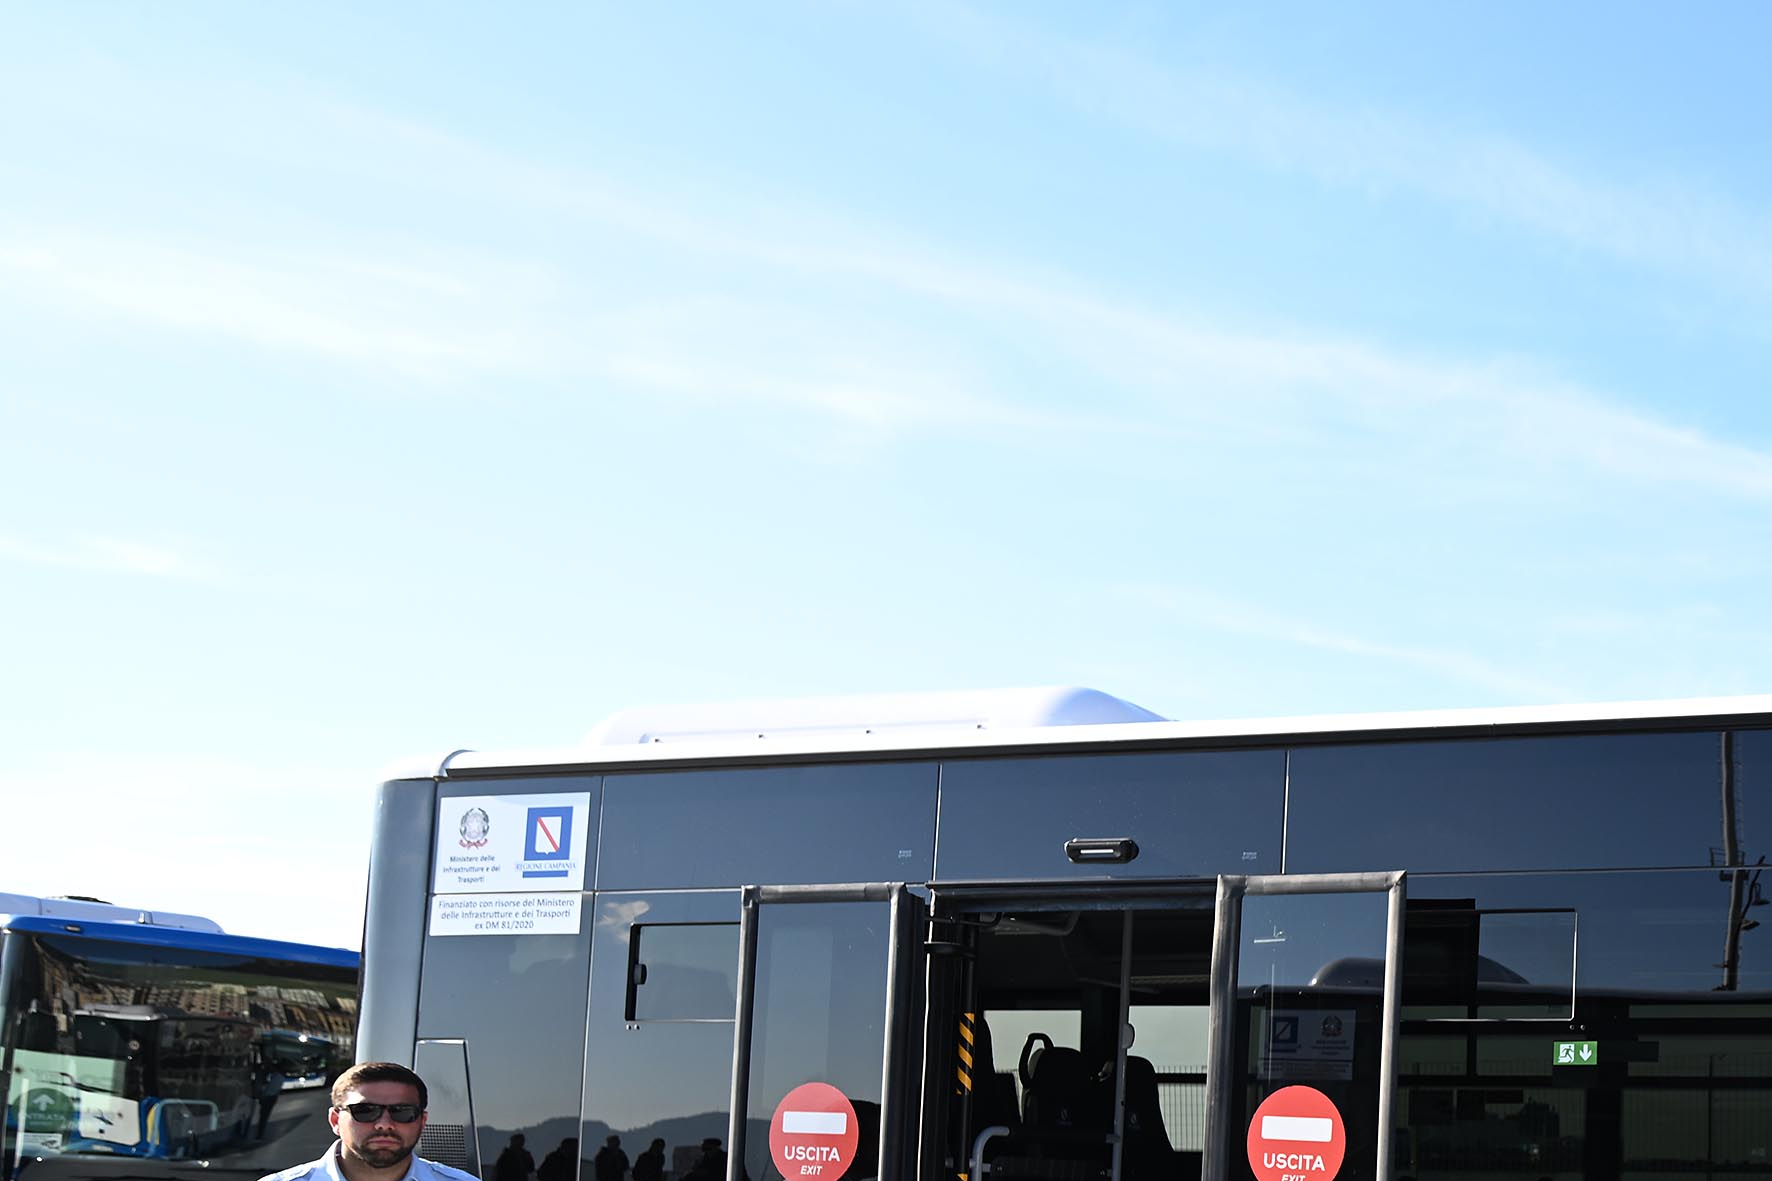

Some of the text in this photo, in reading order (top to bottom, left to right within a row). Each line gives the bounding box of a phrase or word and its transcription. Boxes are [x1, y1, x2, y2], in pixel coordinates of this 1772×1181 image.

[516, 862, 576, 870] REGIONE CAMPANIA
[457, 876, 484, 884] Trasporti
[439, 900, 477, 909] Finanziato
[522, 899, 535, 907] del
[537, 898, 575, 906] Ministero
[441, 911, 459, 920] delle
[461, 910, 513, 919] Infrastrutture
[521, 910, 534, 918] dei
[536, 909, 571, 919] Trasporti
[485, 921, 499, 929] DM
[501, 920, 534, 930] 81/2020
[784, 1146, 841, 1162] USCITA
[1263, 1153, 1326, 1172] USCITA
[800, 1165, 823, 1176] EXIT
